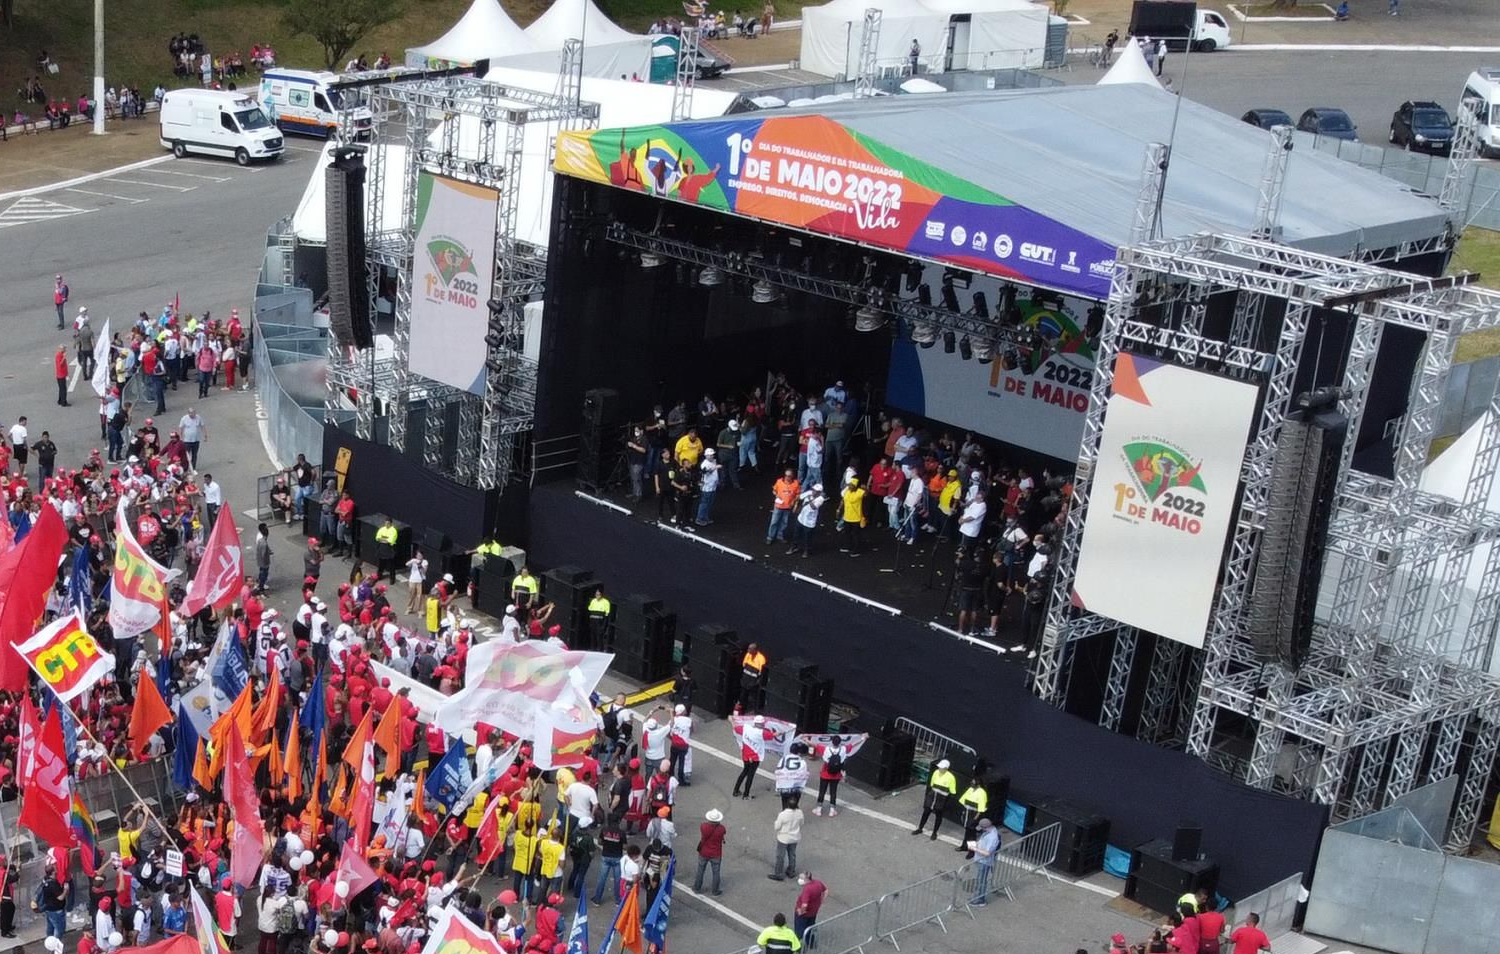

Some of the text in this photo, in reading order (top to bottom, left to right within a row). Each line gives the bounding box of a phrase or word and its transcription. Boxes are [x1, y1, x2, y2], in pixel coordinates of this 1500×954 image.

[758, 141, 771, 152] DIA
[771, 143, 782, 154] DO
[782, 145, 832, 164] TRABALHADOR
[847, 159, 905, 179] TRABALHADORA
[744, 158, 902, 210] DE MAIO 2022
[852, 191, 901, 230] Vida
[433, 287, 445, 300] DE
[447, 290, 477, 309] MAIO
[453, 278, 479, 295] 2022
[1043, 360, 1093, 391] 2022
[1003, 376, 1089, 413] DE MAIO
[1127, 502, 1147, 519] DE
[1151, 507, 1201, 535] MAIO
[1162, 491, 1206, 518] 2022
